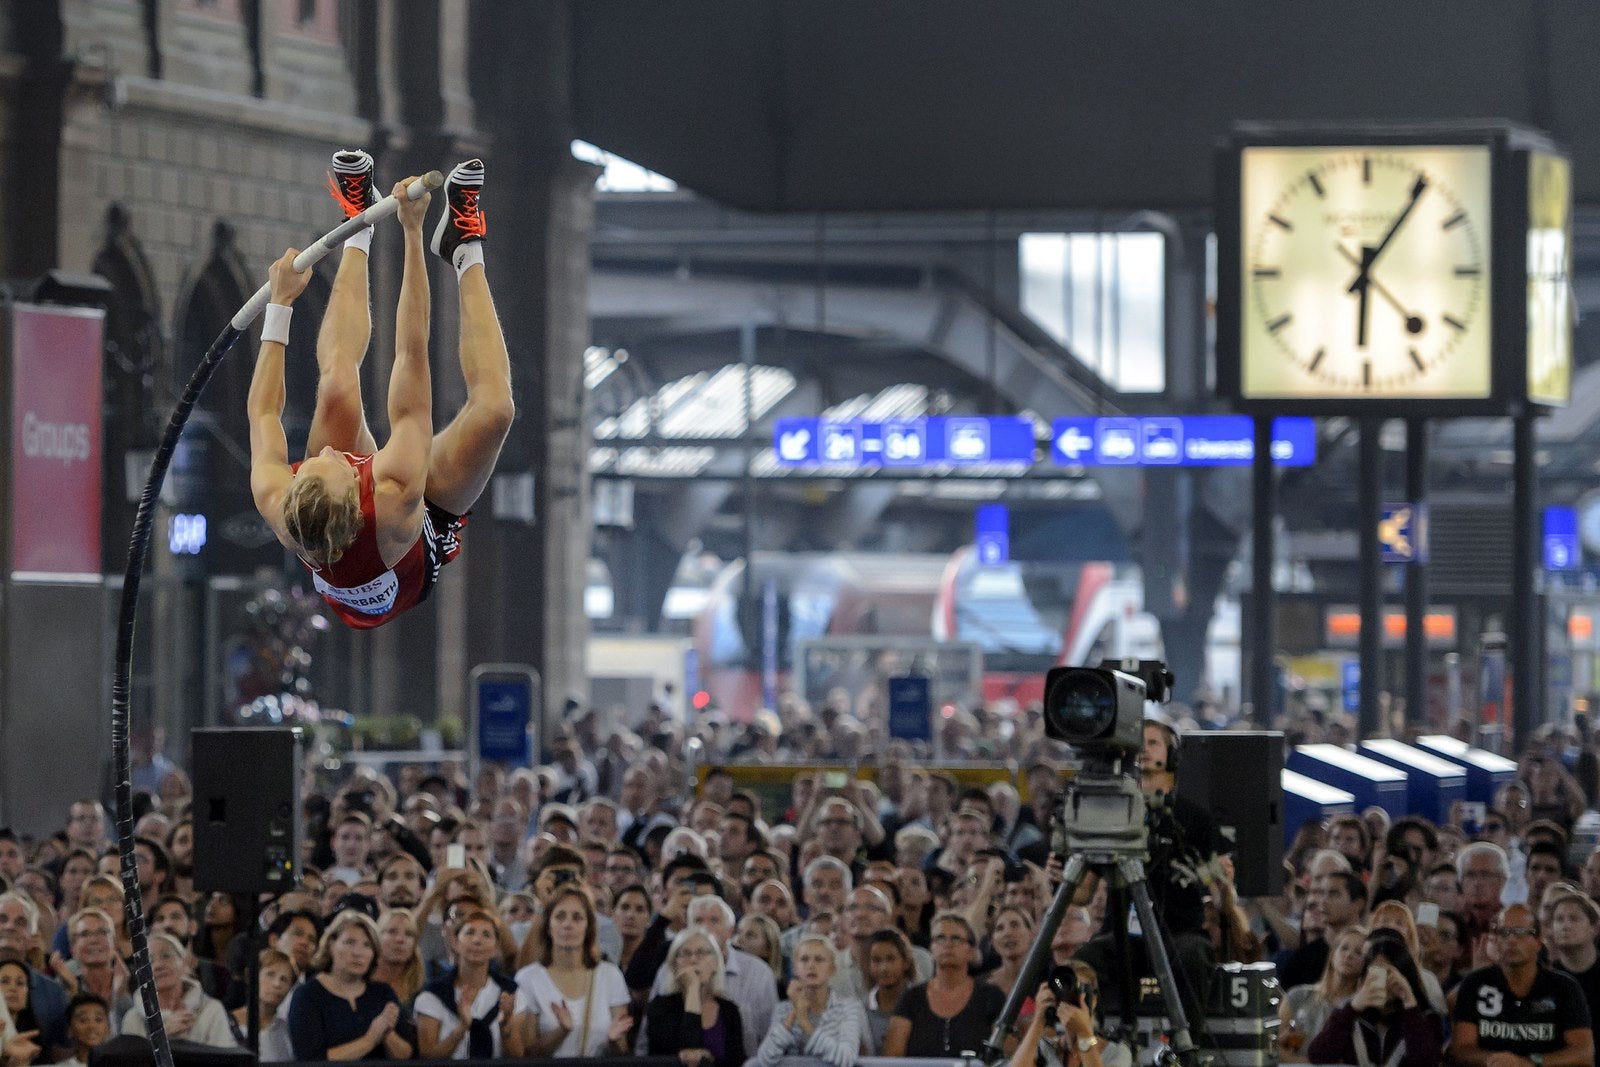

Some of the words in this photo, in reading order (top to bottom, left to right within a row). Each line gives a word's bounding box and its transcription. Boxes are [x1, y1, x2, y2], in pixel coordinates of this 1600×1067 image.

[23, 411, 89, 468] Groups
[321, 581, 397, 606] HERBARTH
[347, 580, 382, 595] UBS
[1230, 977, 1249, 1008] 5
[1477, 985, 1503, 1017] 3
